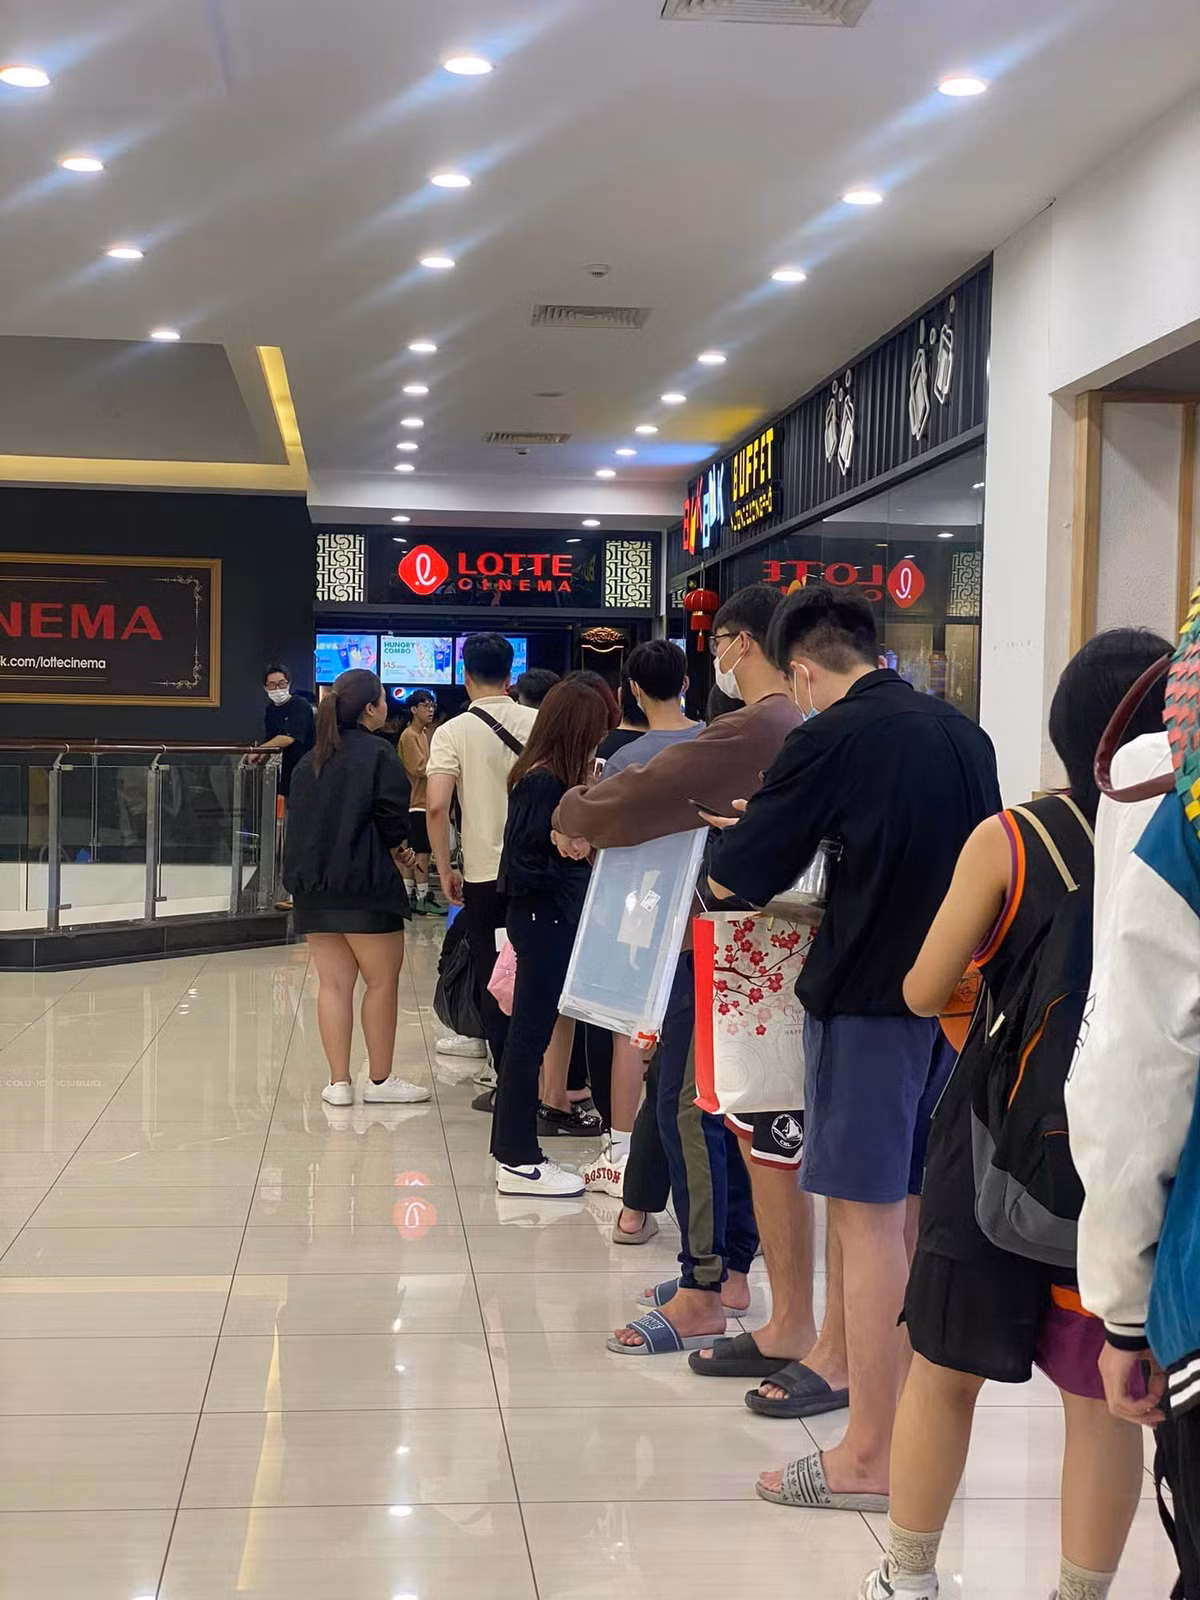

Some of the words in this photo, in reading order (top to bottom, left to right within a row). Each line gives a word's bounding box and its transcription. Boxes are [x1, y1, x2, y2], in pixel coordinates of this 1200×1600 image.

[732, 427, 774, 502] BUFFET
[457, 552, 573, 576] LOTTE
[457, 578, 572, 592] CINEMA
[584, 1167, 621, 1184] BOSTON
